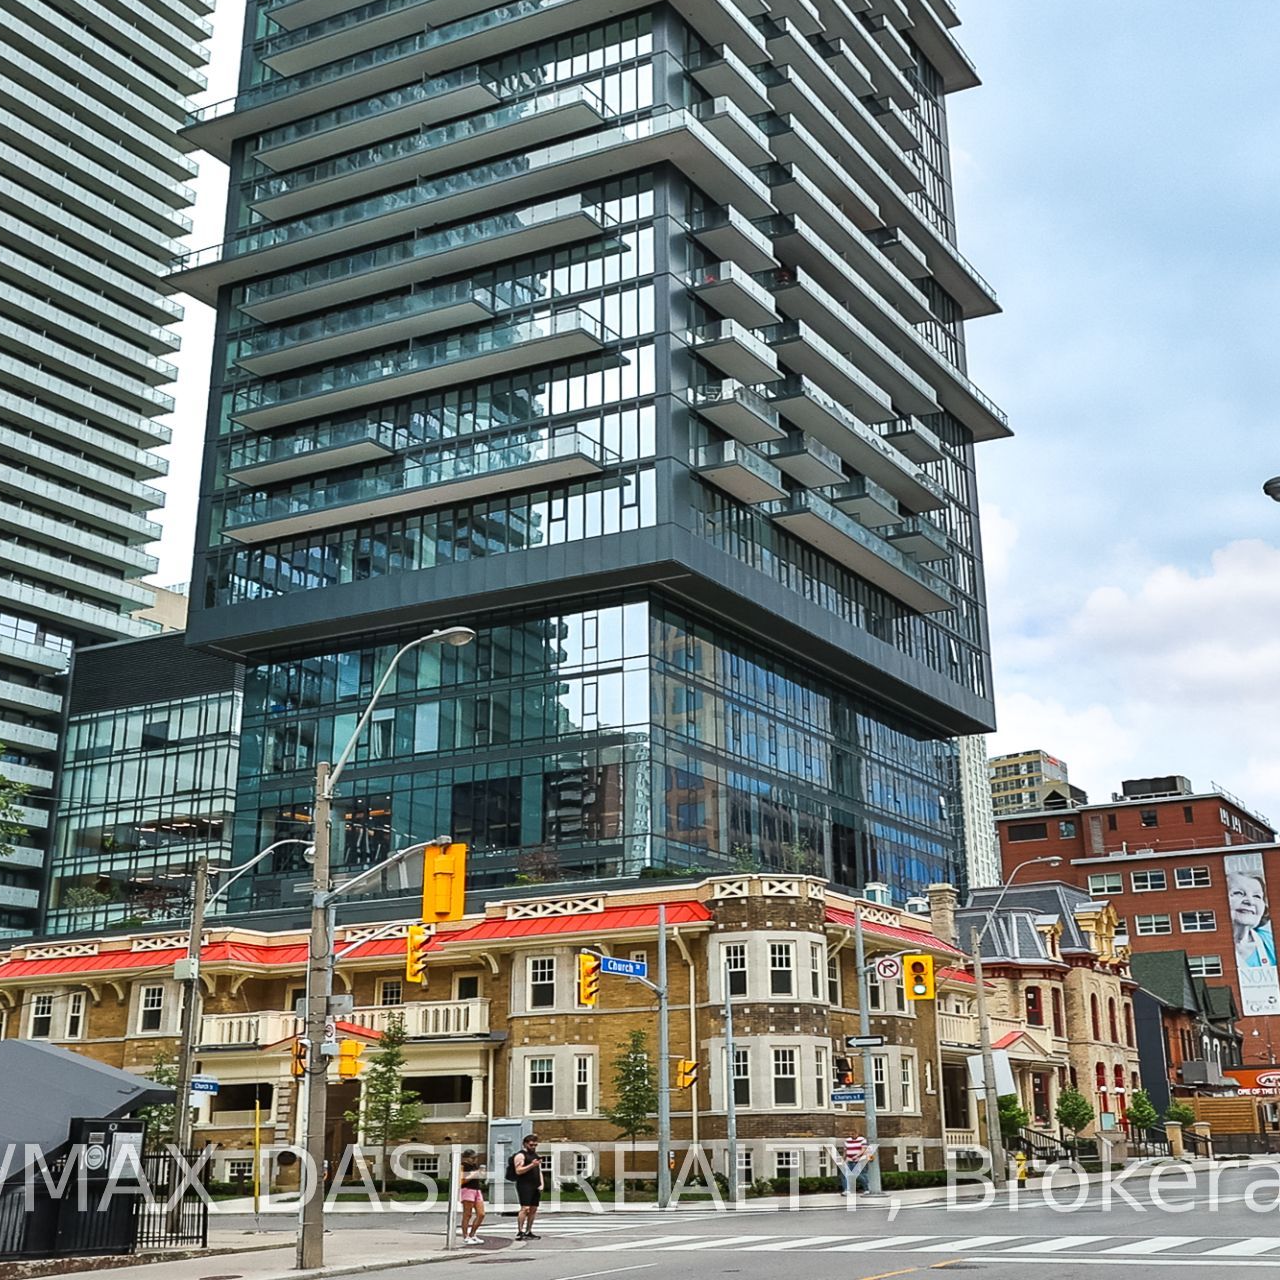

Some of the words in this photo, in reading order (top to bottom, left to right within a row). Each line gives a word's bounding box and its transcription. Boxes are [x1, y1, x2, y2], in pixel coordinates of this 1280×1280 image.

[1227, 855, 1261, 872] GIVE
[608, 960, 634, 973] Church
[1240, 968, 1277, 984] NOW
